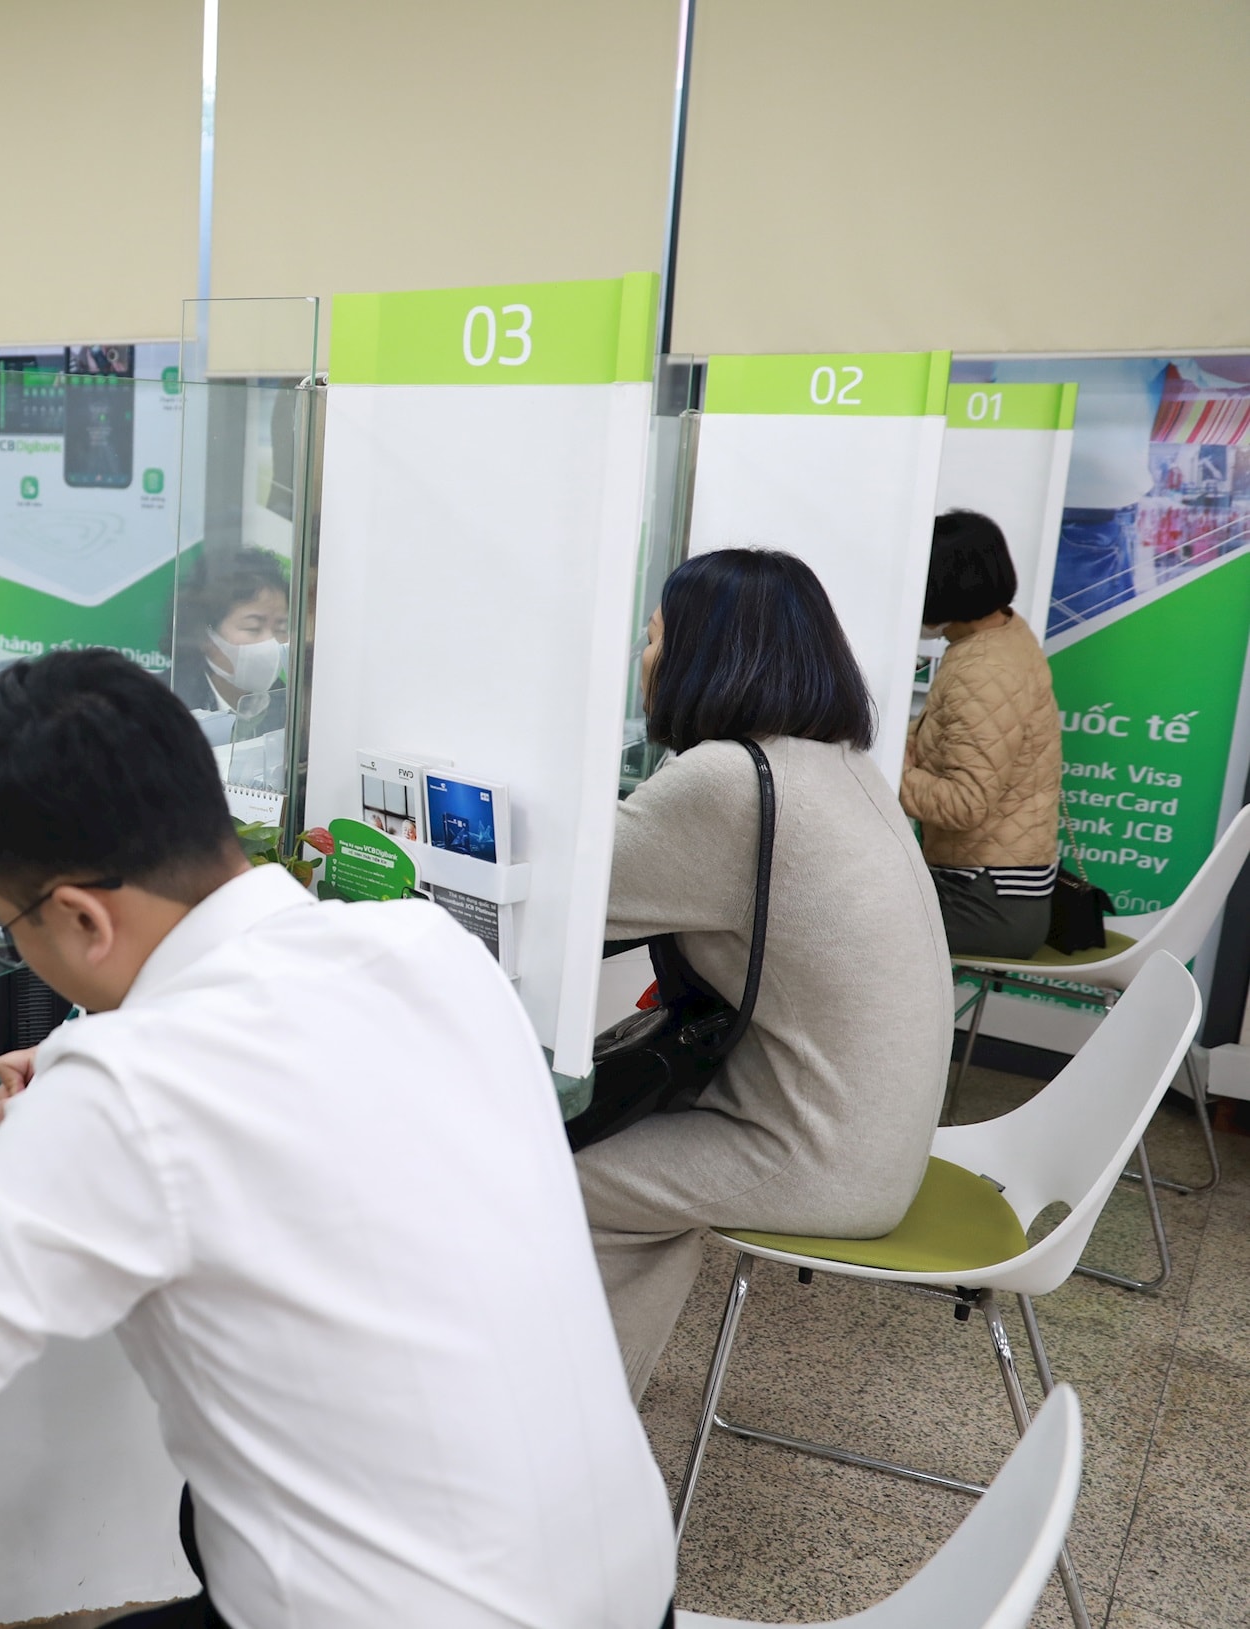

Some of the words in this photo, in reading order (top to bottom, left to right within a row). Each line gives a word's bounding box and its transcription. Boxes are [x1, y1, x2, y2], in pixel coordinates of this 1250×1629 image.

[463, 303, 533, 366] 03
[810, 366, 863, 405] 02
[966, 392, 1002, 421] 01
[1146, 710, 1199, 743] tế
[398, 768, 414, 778] FWD
[1128, 764, 1183, 788] Visa
[1059, 788, 1178, 816] sterCard
[1122, 821, 1173, 843] JCB
